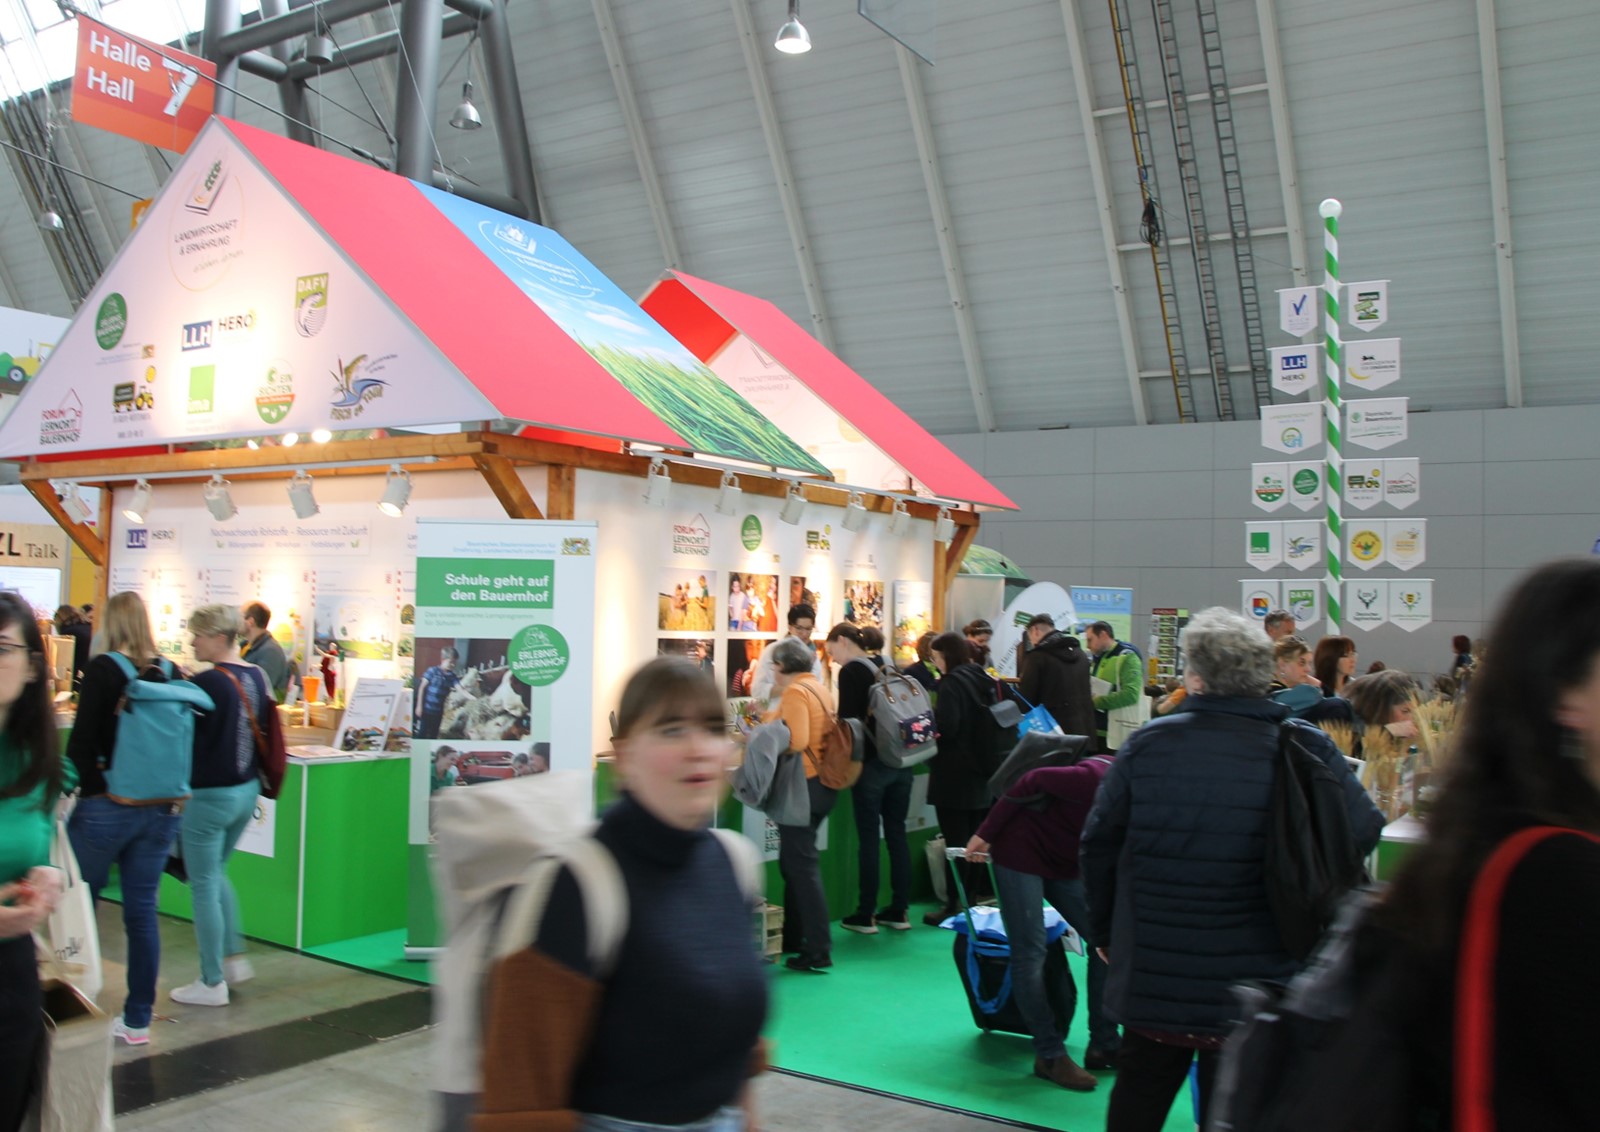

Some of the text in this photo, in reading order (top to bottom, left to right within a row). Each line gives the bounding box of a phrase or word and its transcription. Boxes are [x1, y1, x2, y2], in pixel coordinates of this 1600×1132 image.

[90, 30, 151, 72] Halle
[87, 66, 135, 103] Hall
[162, 56, 199, 116] 7
[297, 276, 328, 293] DAFV
[218, 313, 254, 331] HERO
[183, 325, 212, 349] LLH
[1282, 356, 1306, 369] LLH
[1282, 374, 1305, 382] HERO
[673, 524, 698, 535] FORUM
[127, 528, 174, 548] LLH HERO
[673, 535, 706, 545] LERNORT
[25, 543, 59, 559] Talk
[445, 573, 549, 588] Schule geht auf
[451, 589, 549, 602] den Bauernhof
[518, 647, 559, 660] ERLEBNIS
[512, 656, 567, 671] BAUERNHOF
